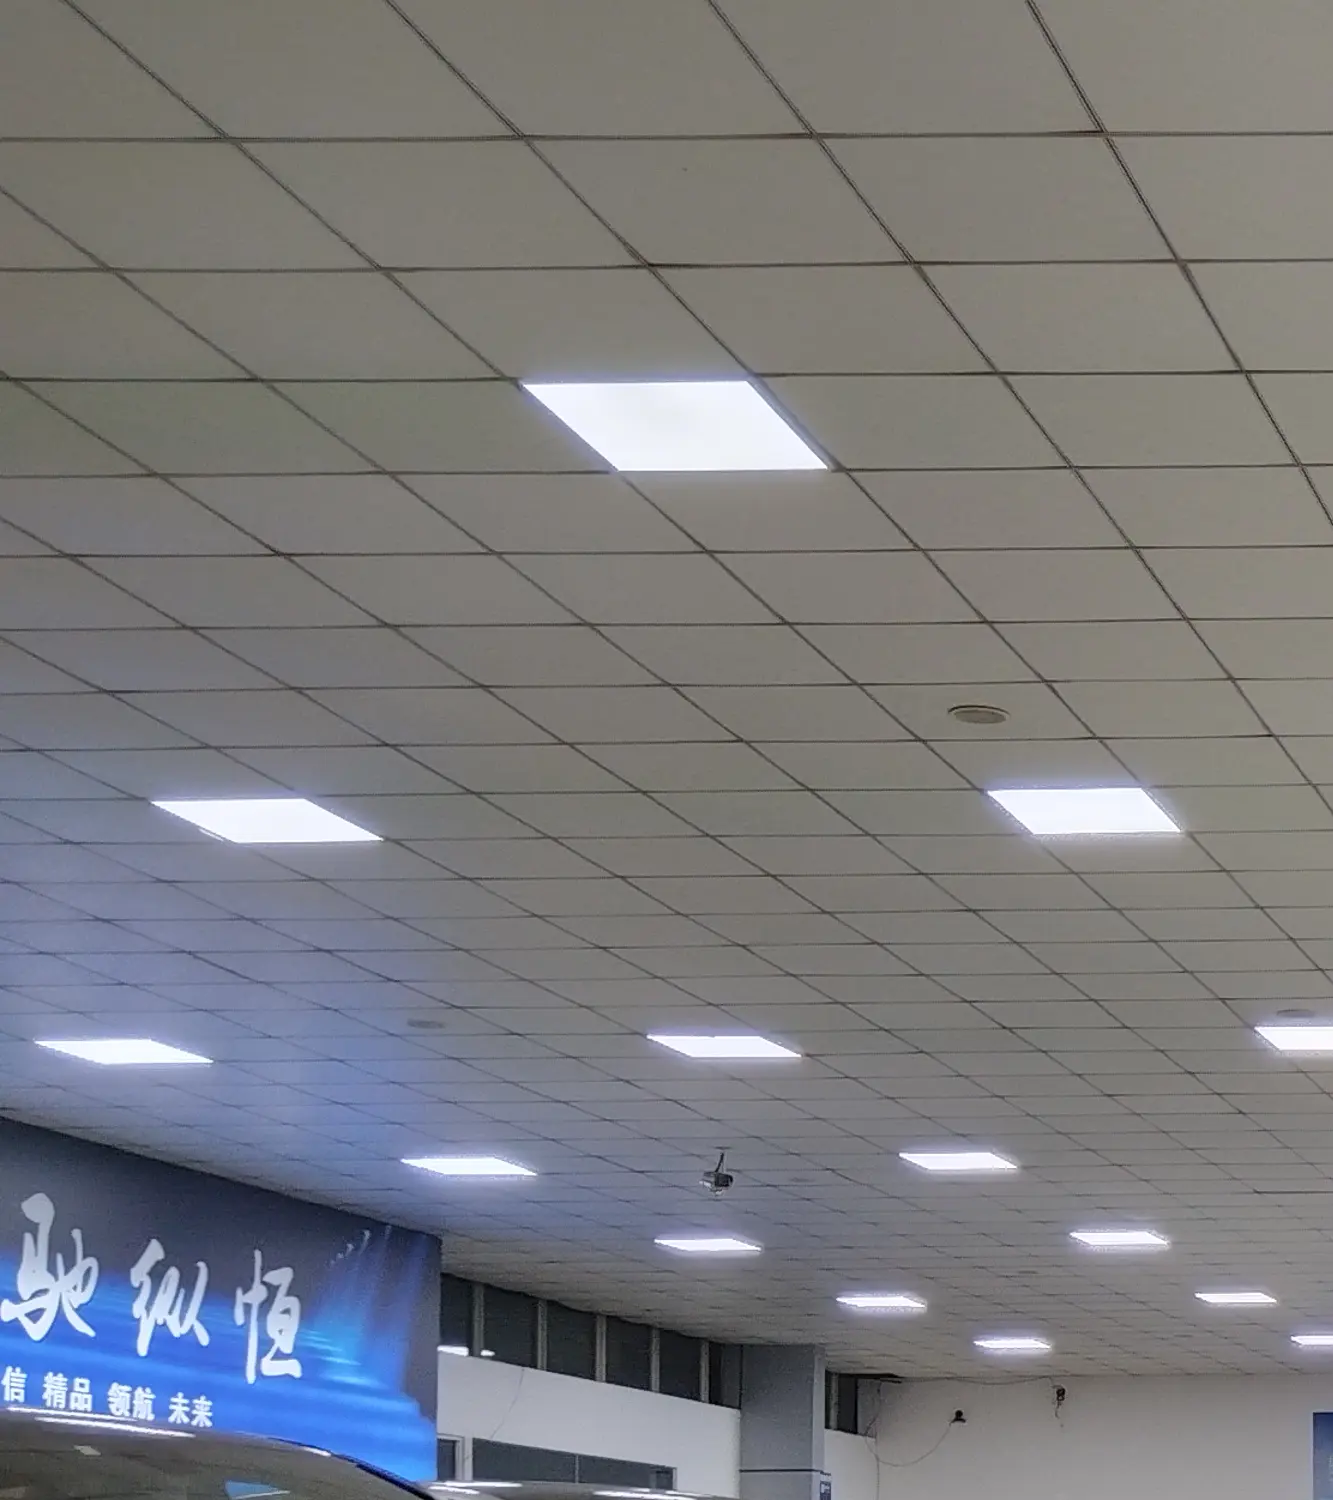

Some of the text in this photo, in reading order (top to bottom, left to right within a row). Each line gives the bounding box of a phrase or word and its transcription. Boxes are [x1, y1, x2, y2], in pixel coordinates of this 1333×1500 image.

[42, 1371, 93, 1412] 精品
[107, 1382, 156, 1420] 领航
[168, 1392, 213, 1427] 未来
